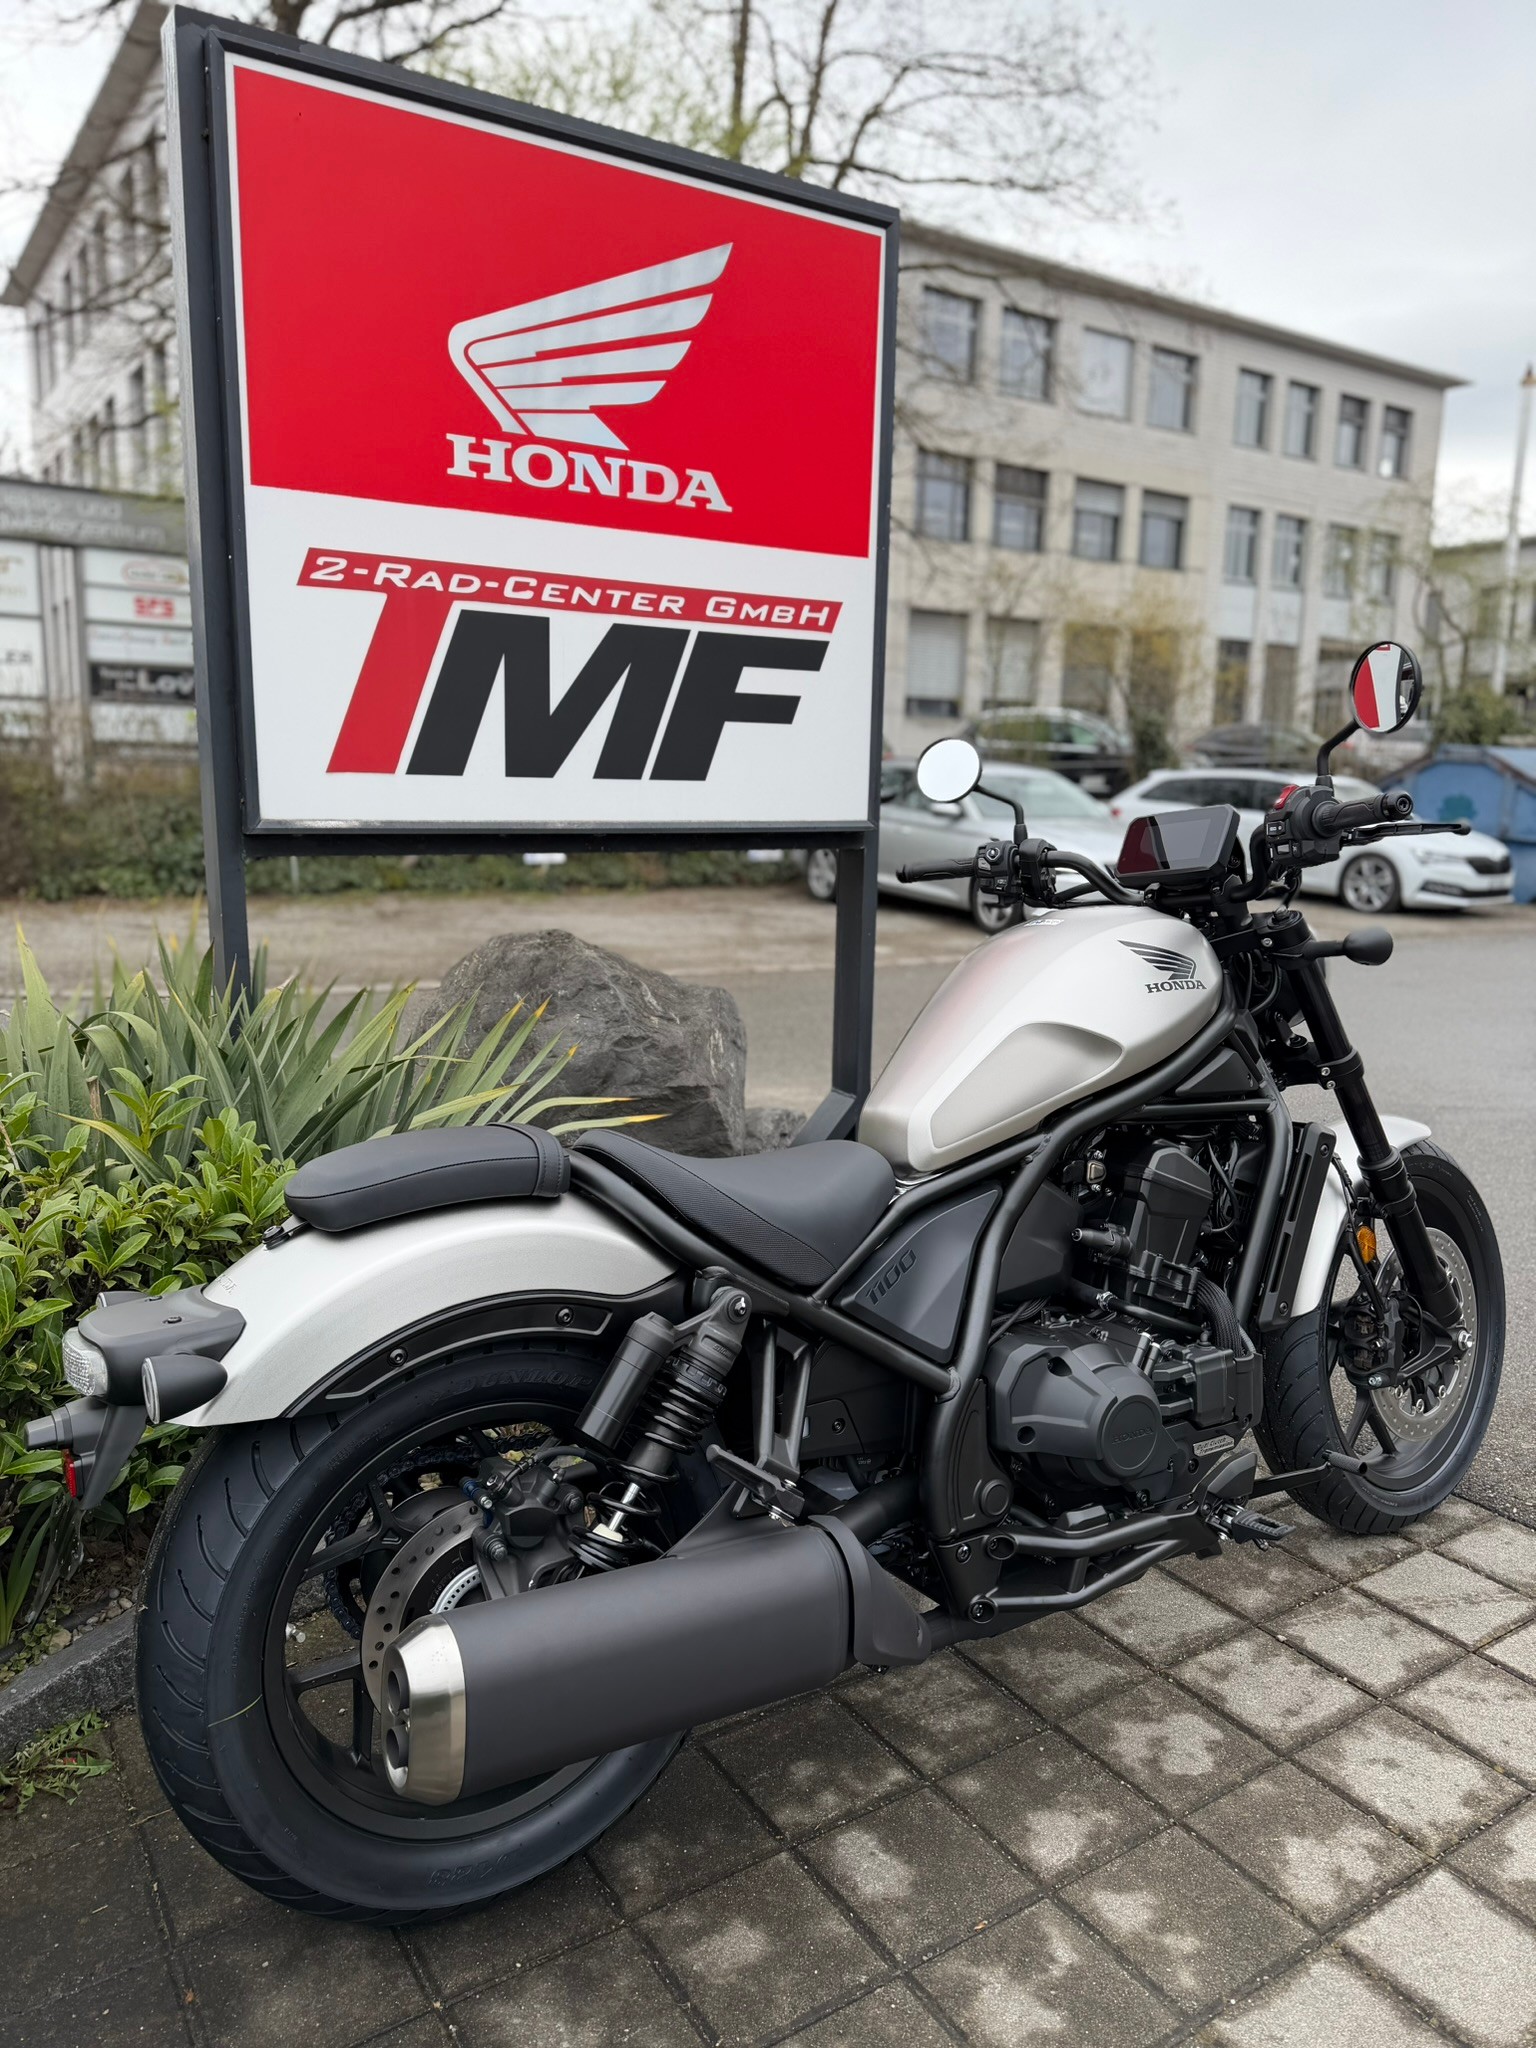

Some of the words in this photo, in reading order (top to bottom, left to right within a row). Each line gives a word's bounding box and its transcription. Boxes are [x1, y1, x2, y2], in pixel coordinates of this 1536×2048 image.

[446, 433, 732, 513] HONDA
[325, 600, 830, 782] TMF
[1145, 980, 1207, 993] HONDA
[866, 1248, 917, 1306] 1100
